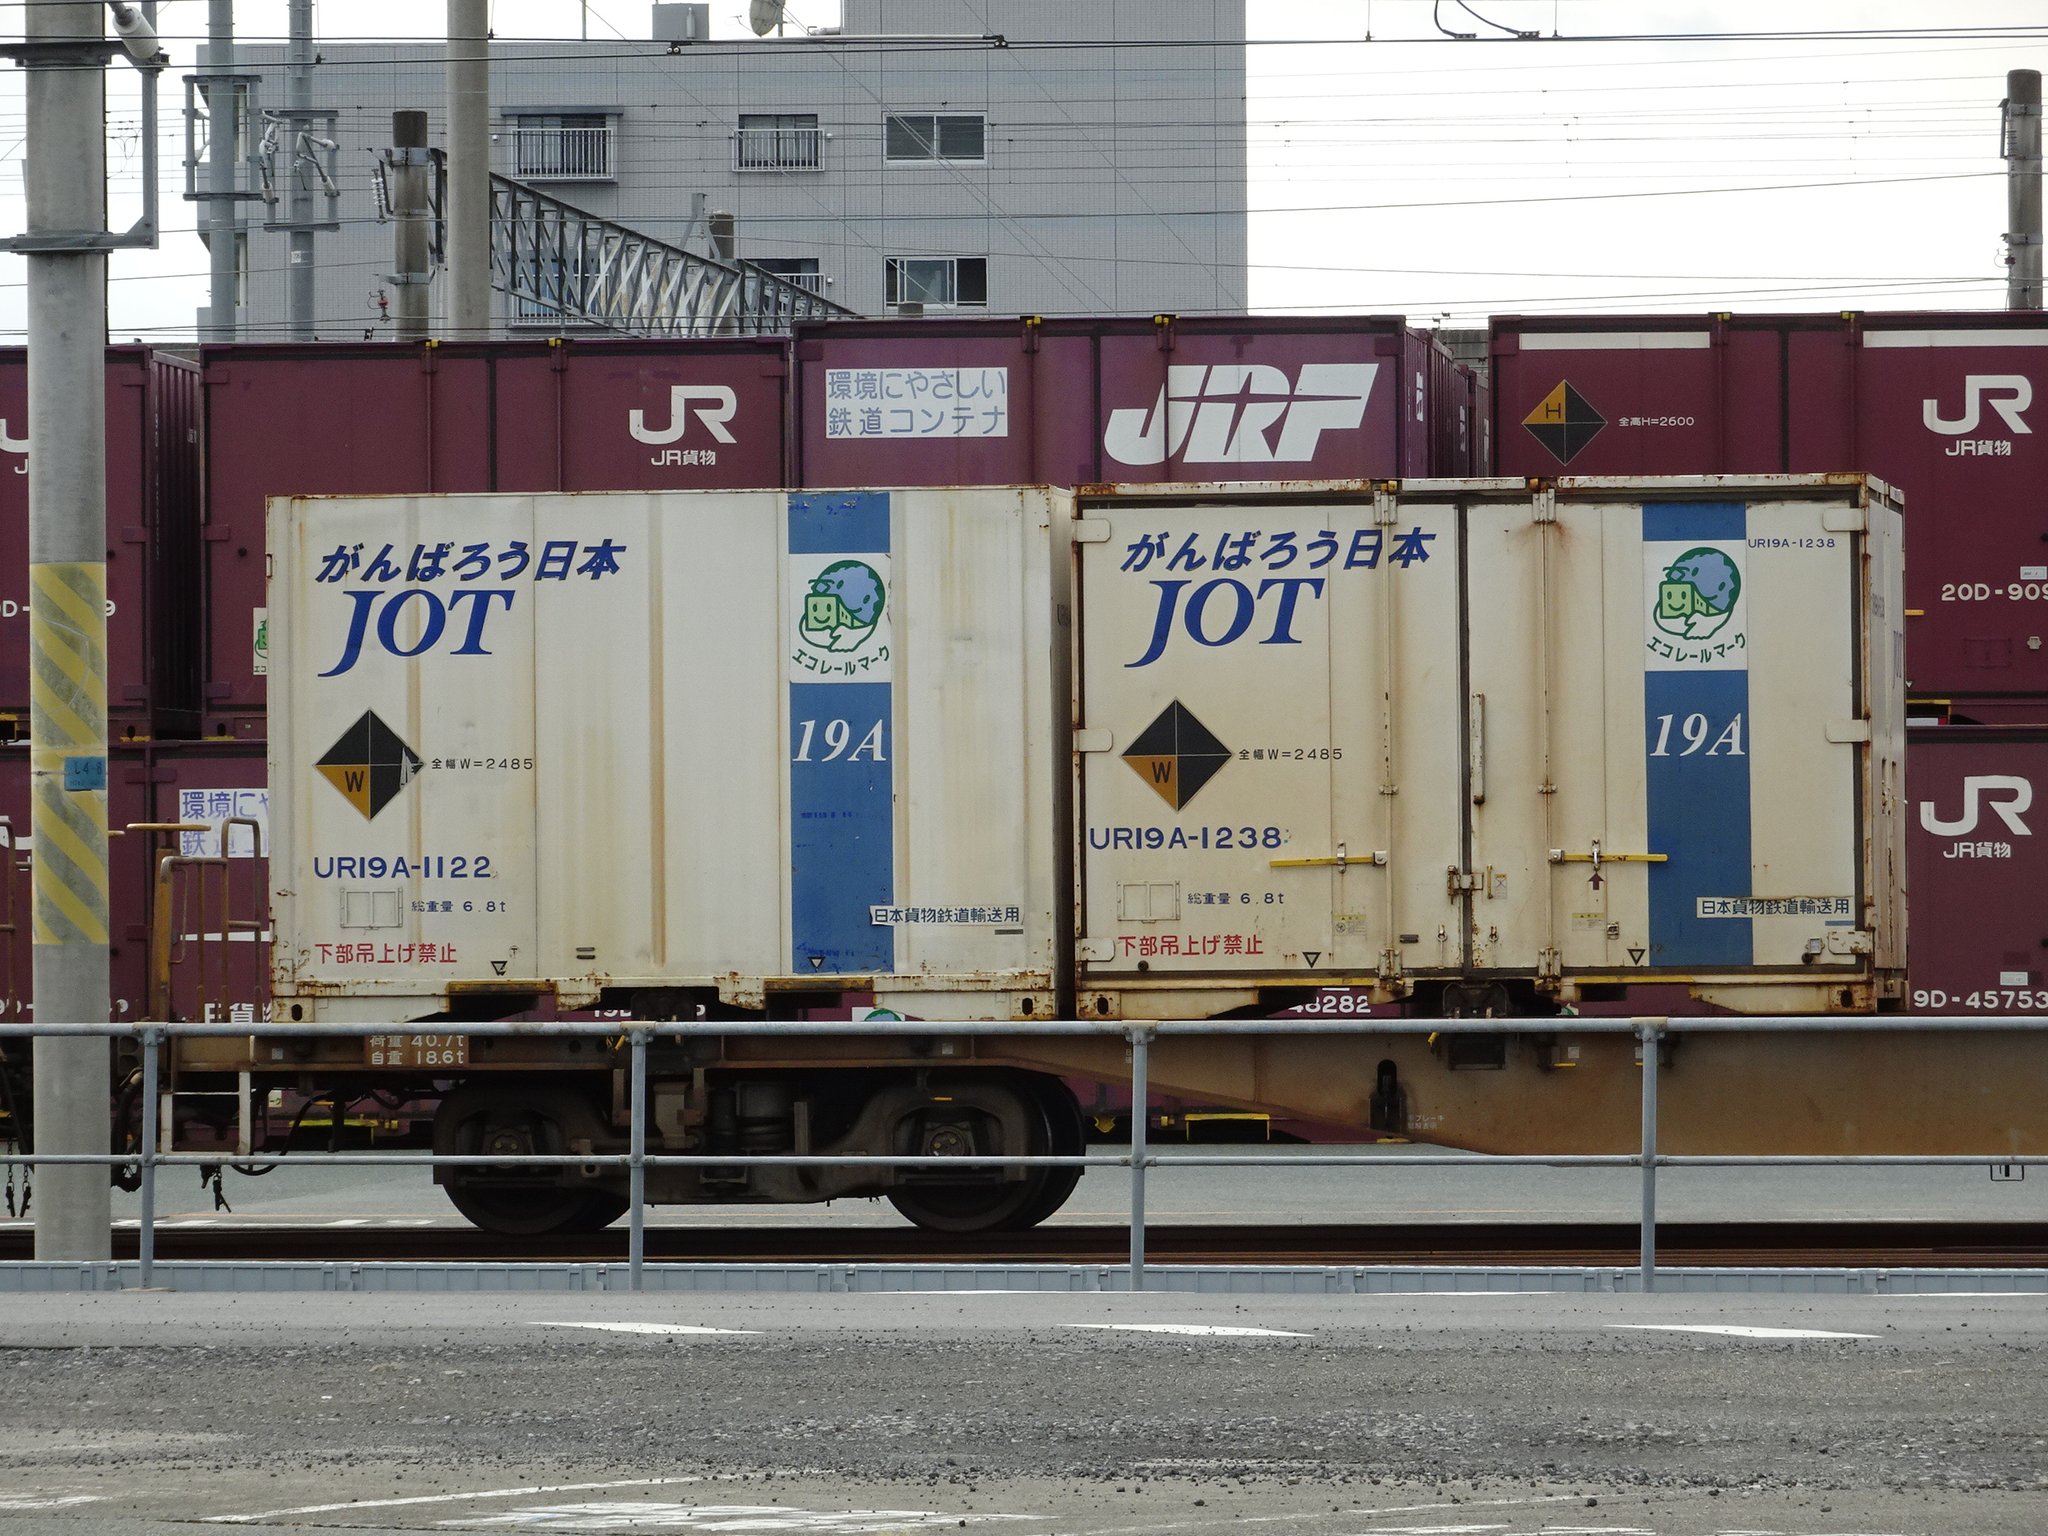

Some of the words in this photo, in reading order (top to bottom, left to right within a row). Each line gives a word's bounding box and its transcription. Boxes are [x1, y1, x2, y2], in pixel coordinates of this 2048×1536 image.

[828, 370, 1006, 400] 環境にやさしい
[629, 385, 737, 445] JR
[1103, 363, 1379, 466] JRF
[1545, 402, 1561, 419] H
[1923, 375, 2032, 434] JR
[828, 406, 1006, 436] 鉄道コンテナ
[1618, 416, 1695, 427] 全高H=2600
[651, 450, 716, 466] JR貨物
[1945, 440, 2012, 456] JR貨物
[1120, 527, 1436, 572] がんばろう日本
[1748, 538, 1835, 548] UR19A-1238
[315, 539, 627, 583] がんばろう日本
[317, 589, 516, 677] JOT
[1124, 578, 1325, 668] JOT
[1646, 633, 1746, 663] エコレールマーク
[792, 645, 890, 676] エコレールマーク
[792, 719, 887, 762] 19A
[1650, 712, 1746, 757] 19A
[345, 770, 364, 793] W
[1151, 761, 1172, 784] W
[1920, 775, 2033, 837] JR
[1090, 827, 1282, 850] UR19A-1238
[1943, 842, 2011, 859] JR貨物
[314, 856, 491, 879] UR19A-1122
[411, 901, 454, 913] 総重量
[1187, 893, 1231, 905] 総重量
[1702, 899, 1849, 915] 日本貨物鉄道輸送用
[874, 907, 1019, 923] 日本貨物鉄道輸送用
[314, 943, 458, 964] 下部吊上げ禁止
[1118, 935, 1264, 956] 下部吊上げ禁止
[417, 1050, 464, 1065] 18.6t
